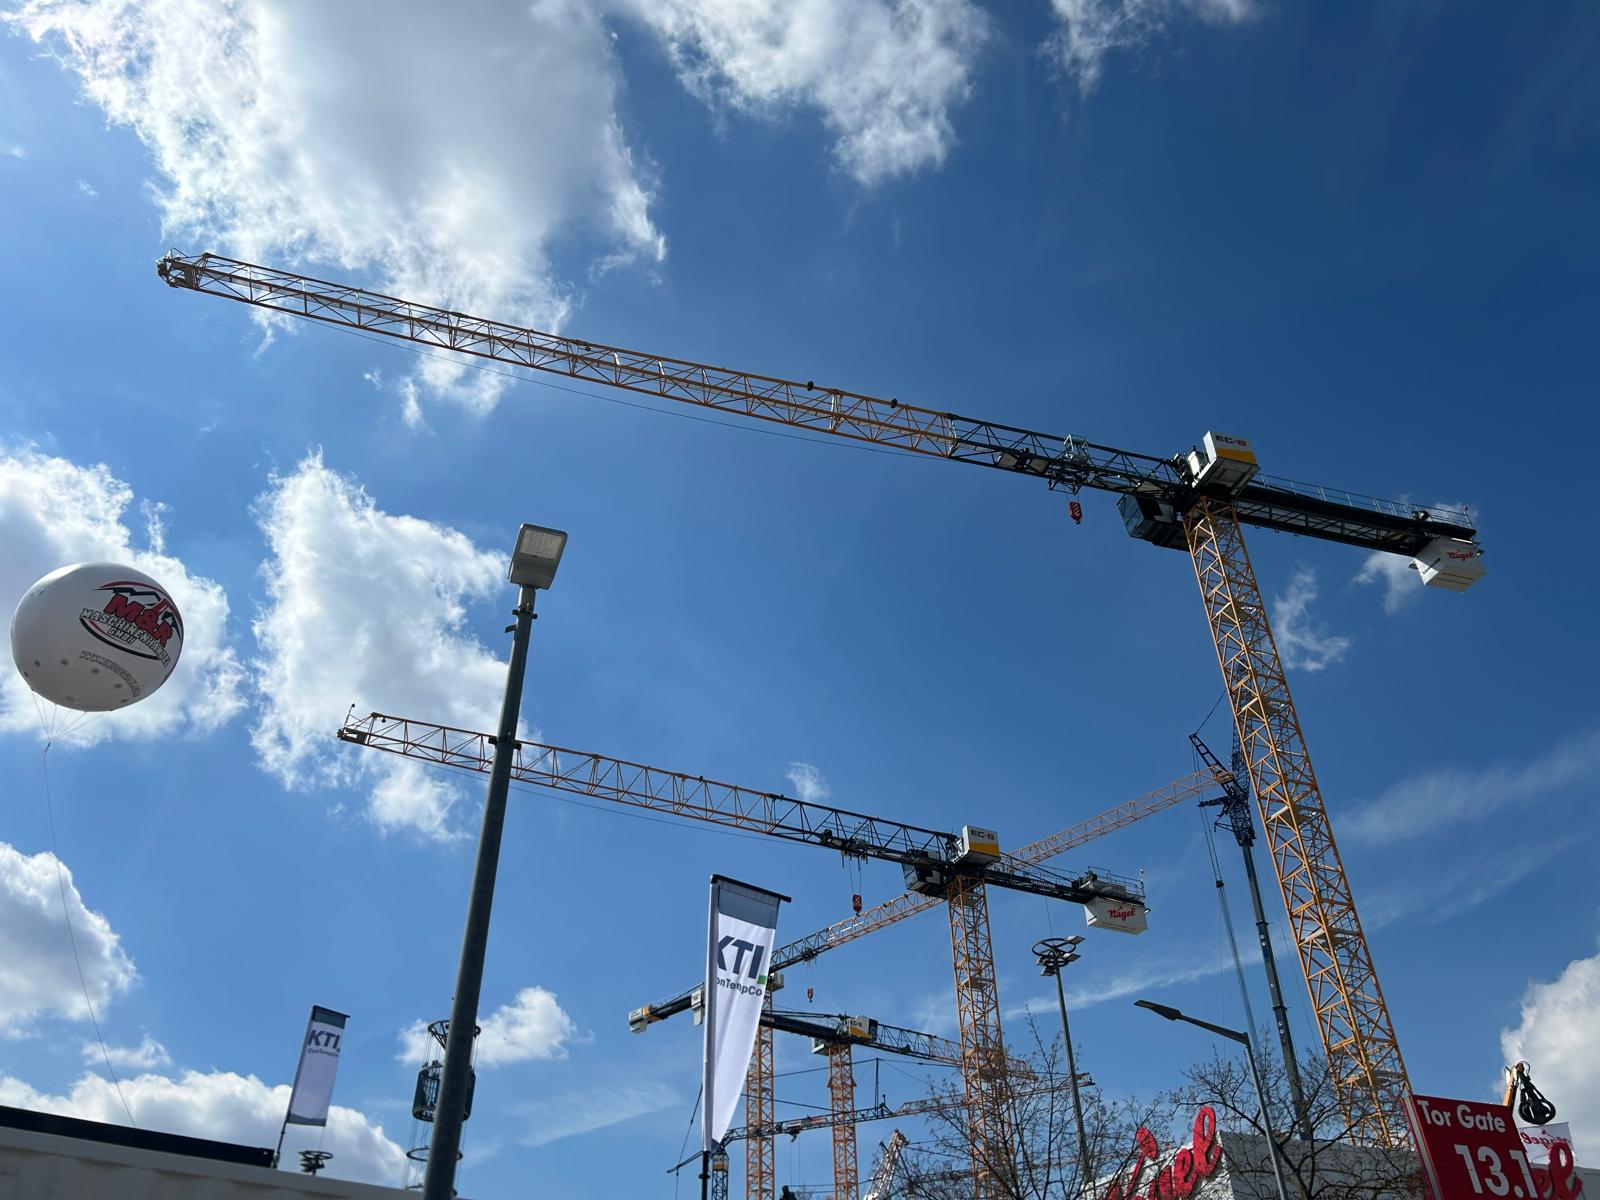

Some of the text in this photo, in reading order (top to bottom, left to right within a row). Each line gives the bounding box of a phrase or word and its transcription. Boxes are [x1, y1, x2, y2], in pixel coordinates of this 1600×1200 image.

[1215, 435, 1247, 447] EC-B
[971, 830, 995, 840] EC-B
[308, 1029, 341, 1049] KTI
[1417, 1100, 1506, 1133] Tor Gate
[1454, 1144, 1538, 1199] 13.1
